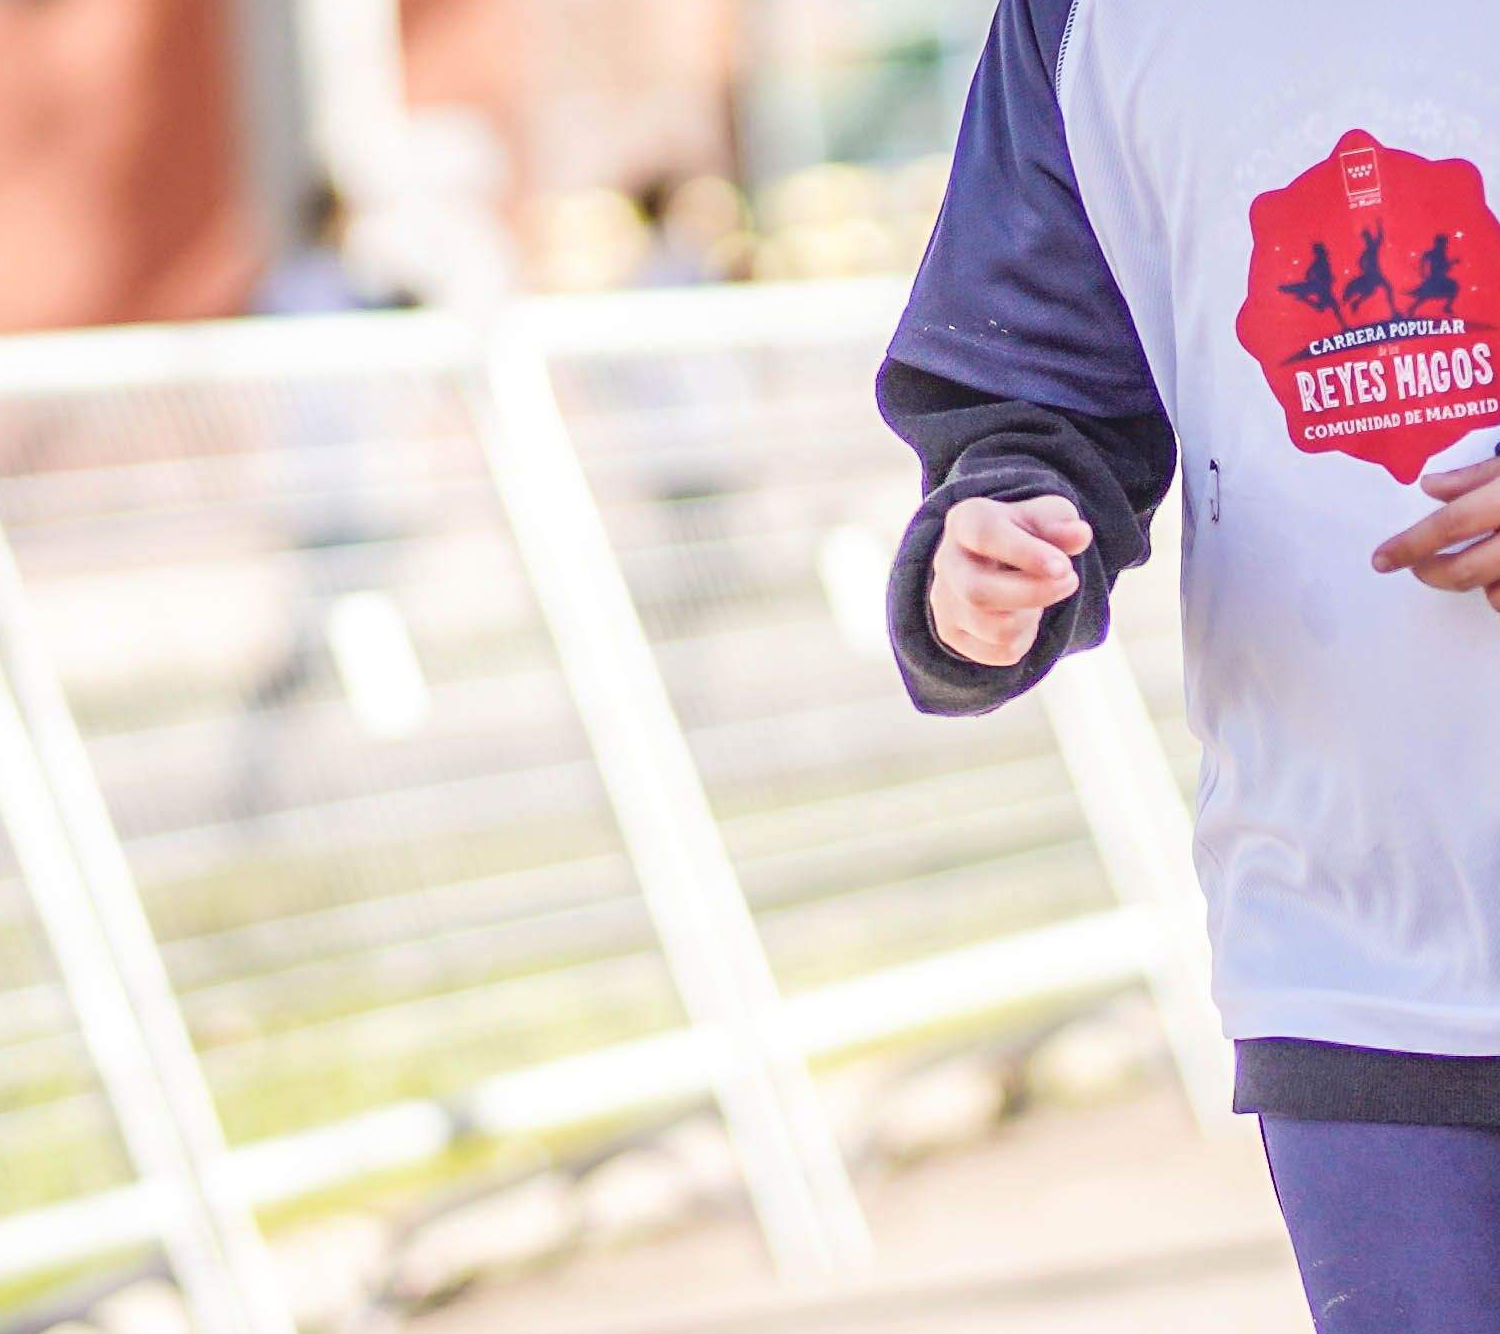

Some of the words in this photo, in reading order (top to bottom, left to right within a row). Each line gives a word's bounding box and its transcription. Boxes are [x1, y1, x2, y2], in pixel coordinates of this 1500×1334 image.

[1309, 325, 1386, 355] CARRERA
[1389, 319, 1466, 337] POPULAR
[1295, 360, 1388, 412] REYES
[1393, 343, 1493, 400] MAGOS
[1304, 413, 1400, 440] COMUNIDAD
[1405, 410, 1423, 425] DE
[1426, 398, 1498, 422] MADRID
